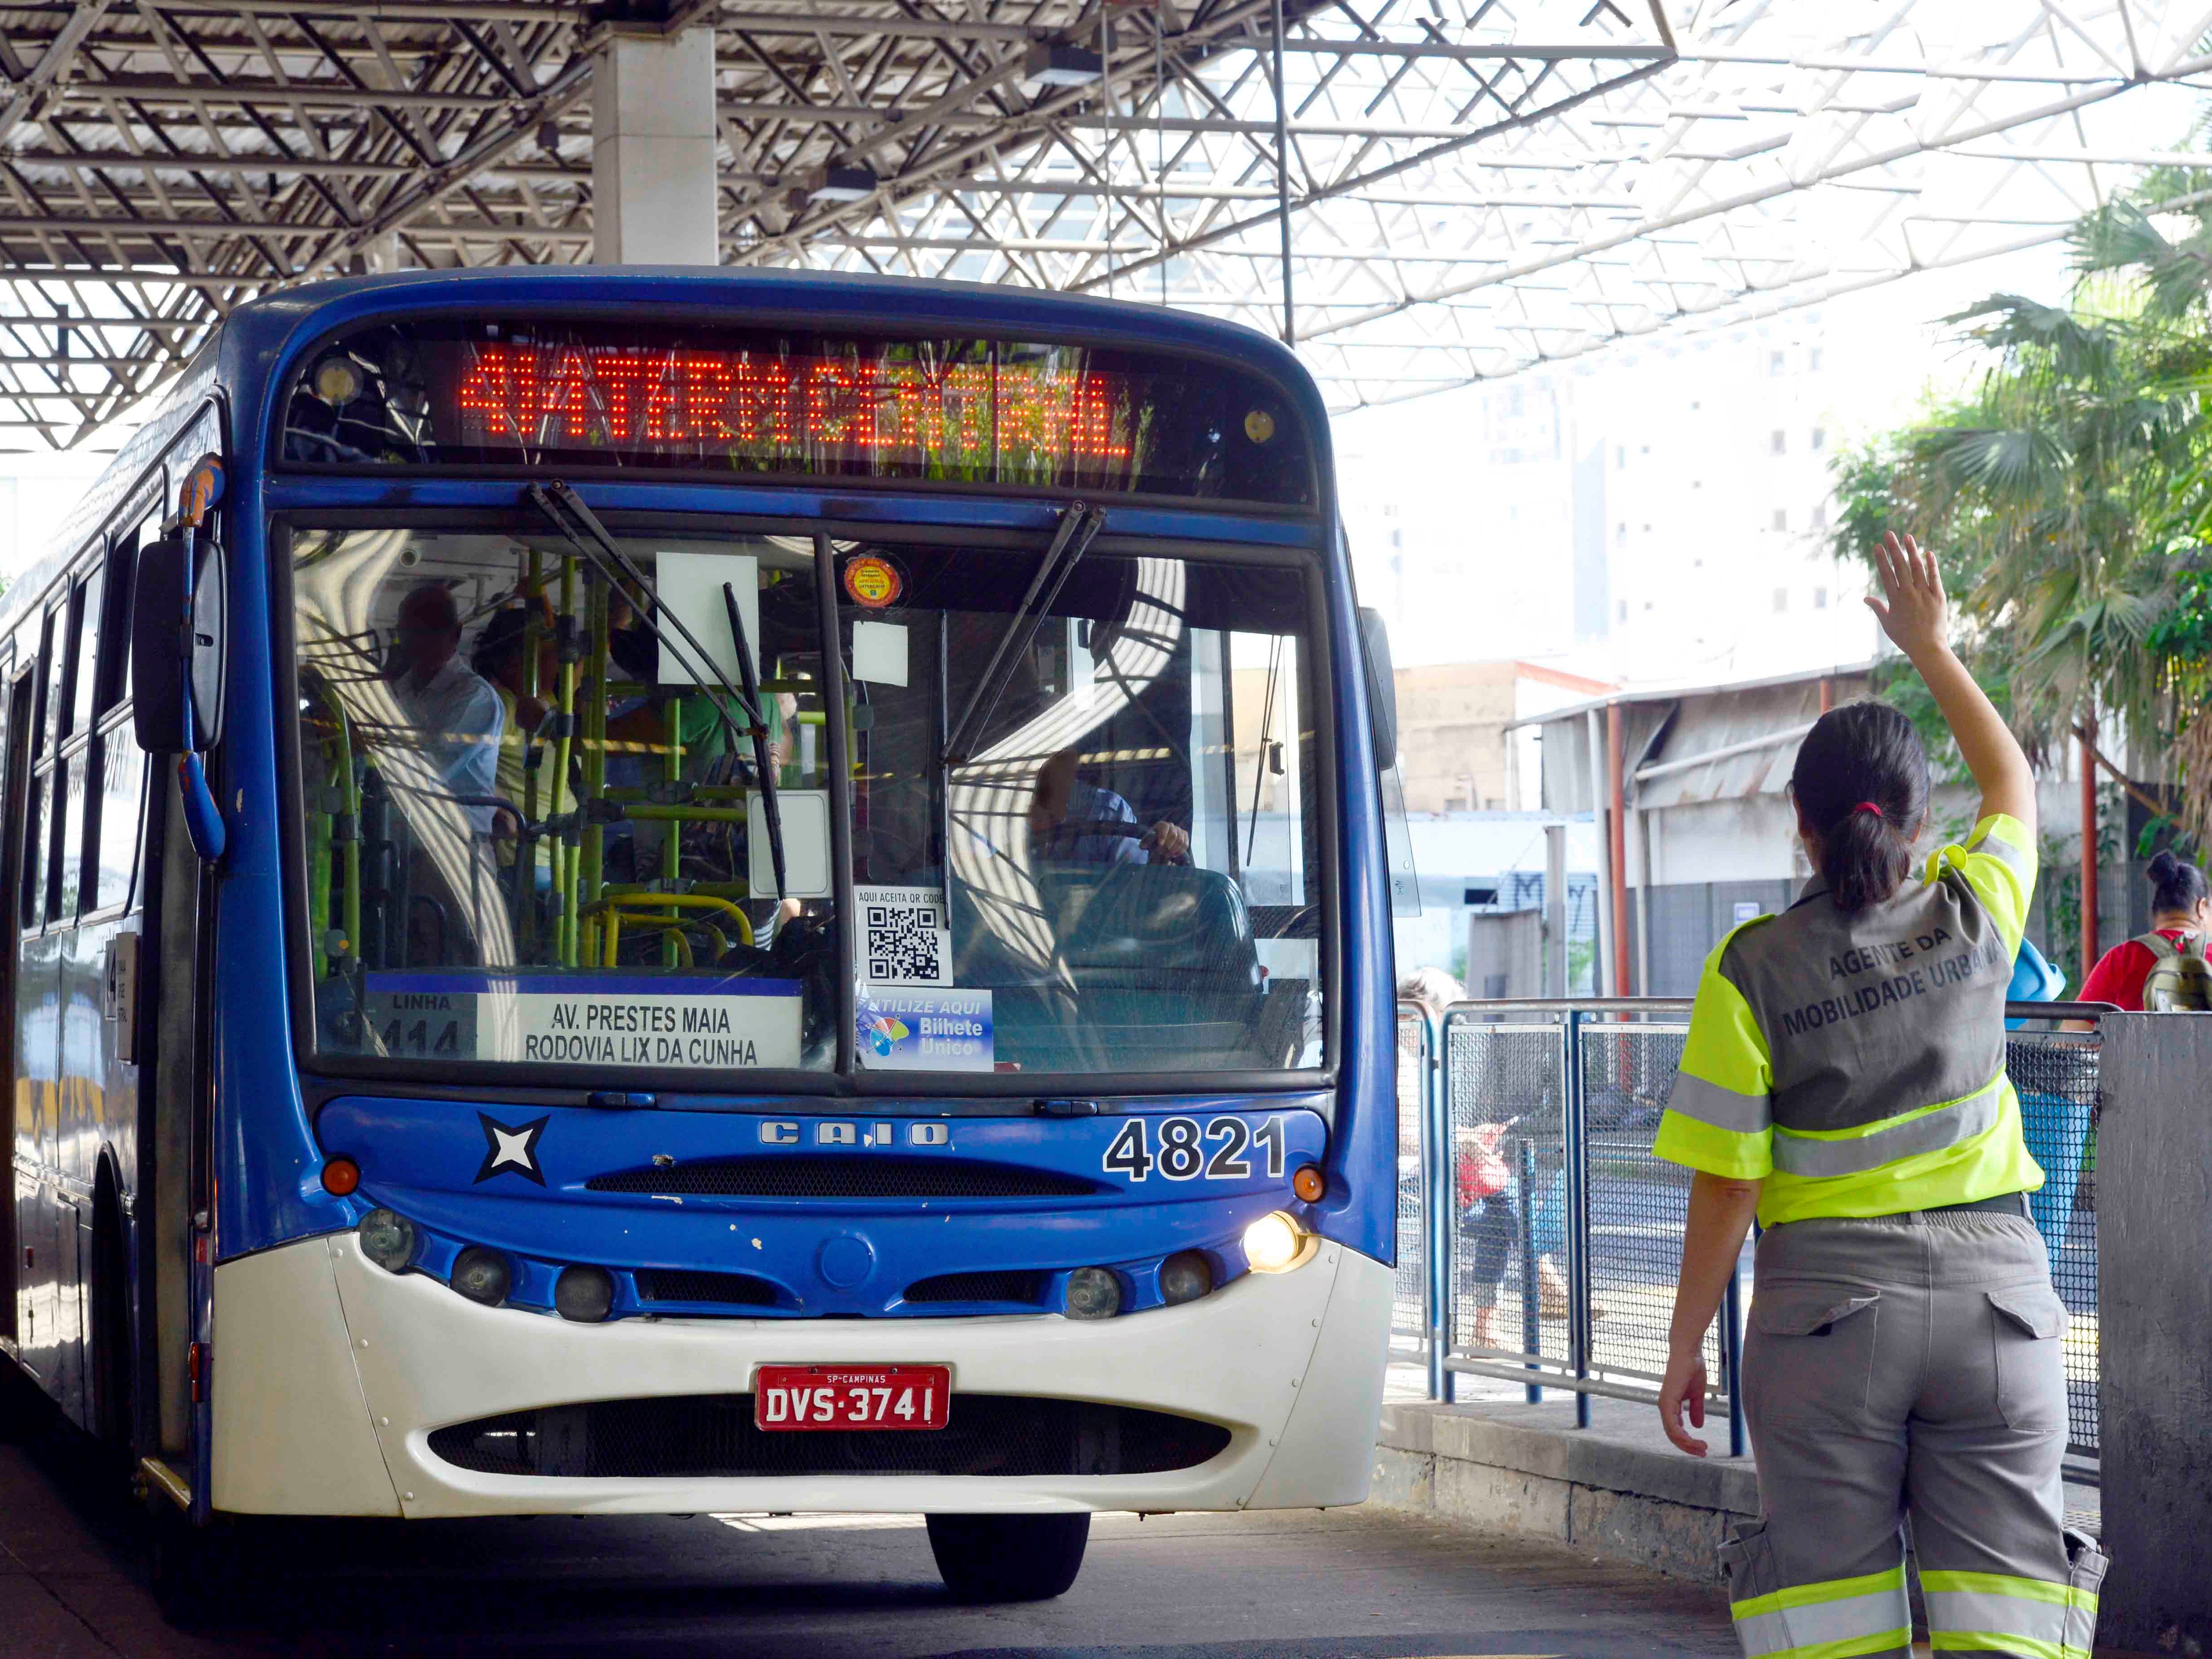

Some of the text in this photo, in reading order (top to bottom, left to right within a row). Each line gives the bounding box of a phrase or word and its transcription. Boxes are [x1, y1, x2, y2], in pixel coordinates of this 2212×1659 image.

[859, 892, 945, 904] AQUI ACEITA QR CODE
[1828, 927, 1952, 981] AGENTE DA
[393, 994, 451, 1010] LINHA
[939, 1001, 981, 1015] AQUI
[1781, 969, 1926, 1036] MOBILIDADE
[551, 1003, 731, 1034] AV. PRESTES MAIA
[920, 1017, 983, 1036] Bilhete
[525, 1034, 758, 1066] RODOVIA LIX DA CUNHA
[760, 1121, 949, 1146] CAIO
[1102, 1115, 1285, 1182] 4821
[826, 1375, 886, 1384] SP-CAMPINAS
